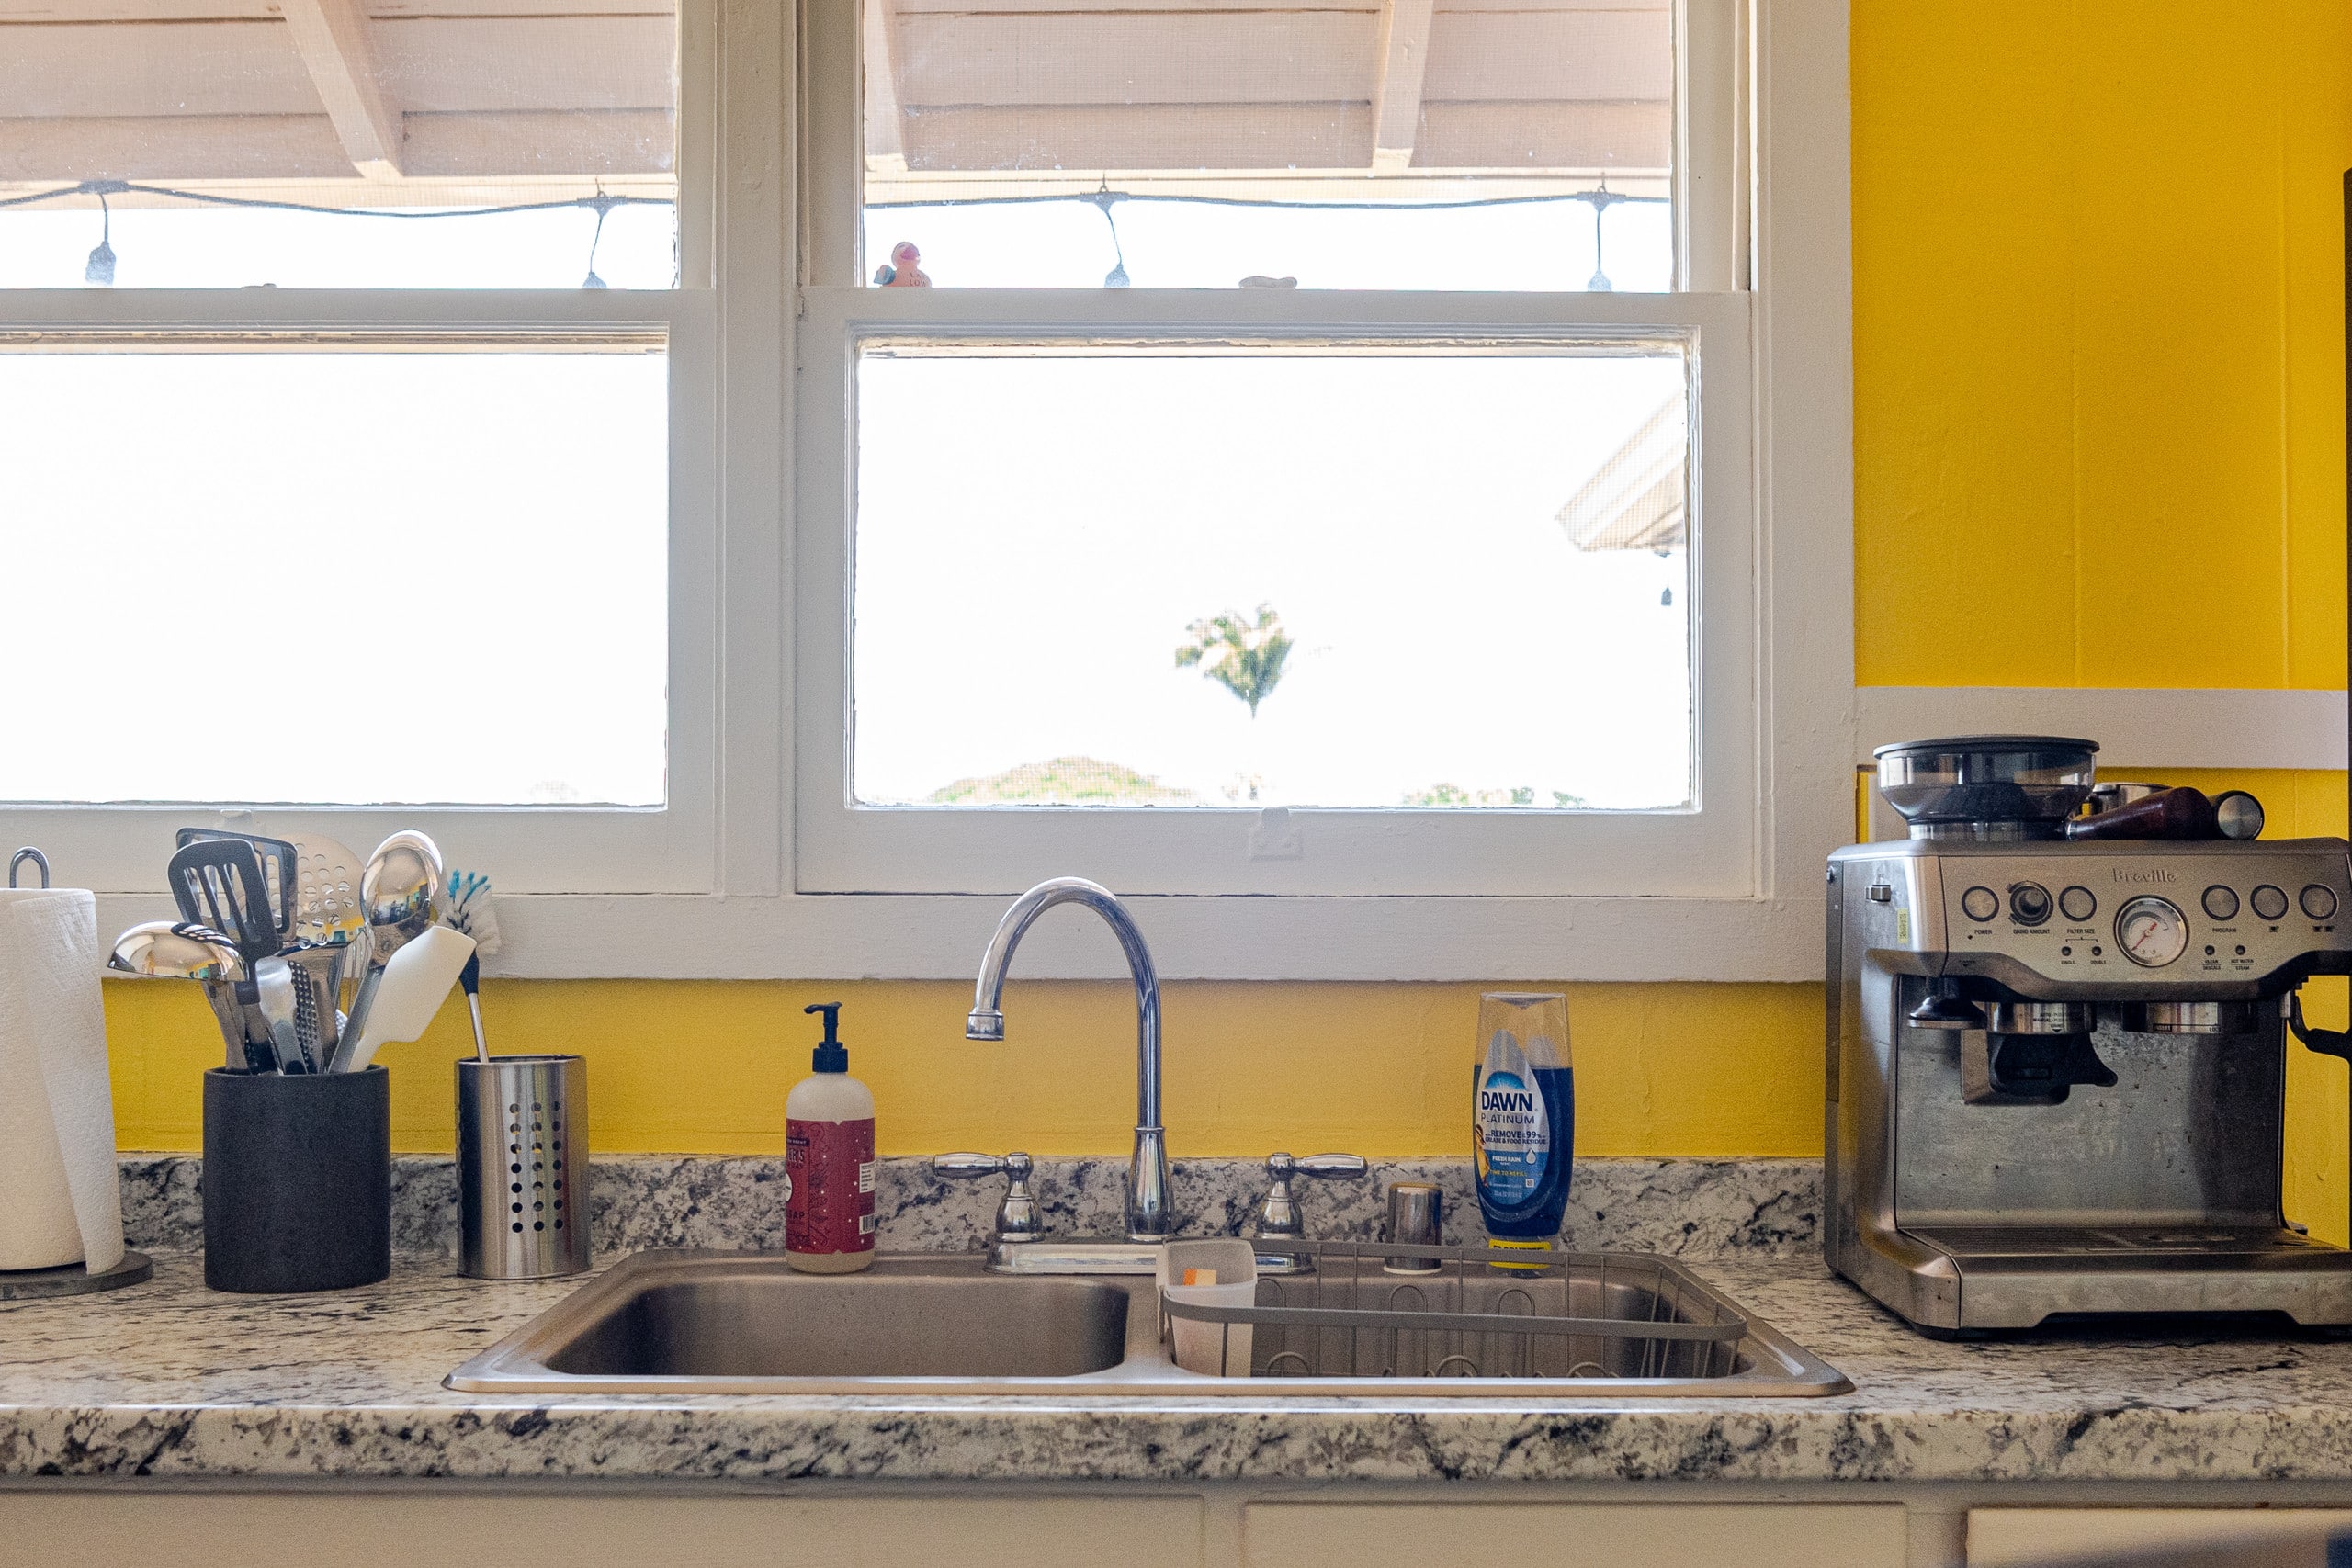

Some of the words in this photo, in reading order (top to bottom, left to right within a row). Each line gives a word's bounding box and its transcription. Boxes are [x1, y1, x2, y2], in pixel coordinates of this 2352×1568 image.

[2113, 868, 2177, 882] Breville
[1481, 1091, 1532, 1112] DAWN
[1481, 1112, 1535, 1124] PLATINUM
[1491, 1130, 1521, 1138] REMOVE
